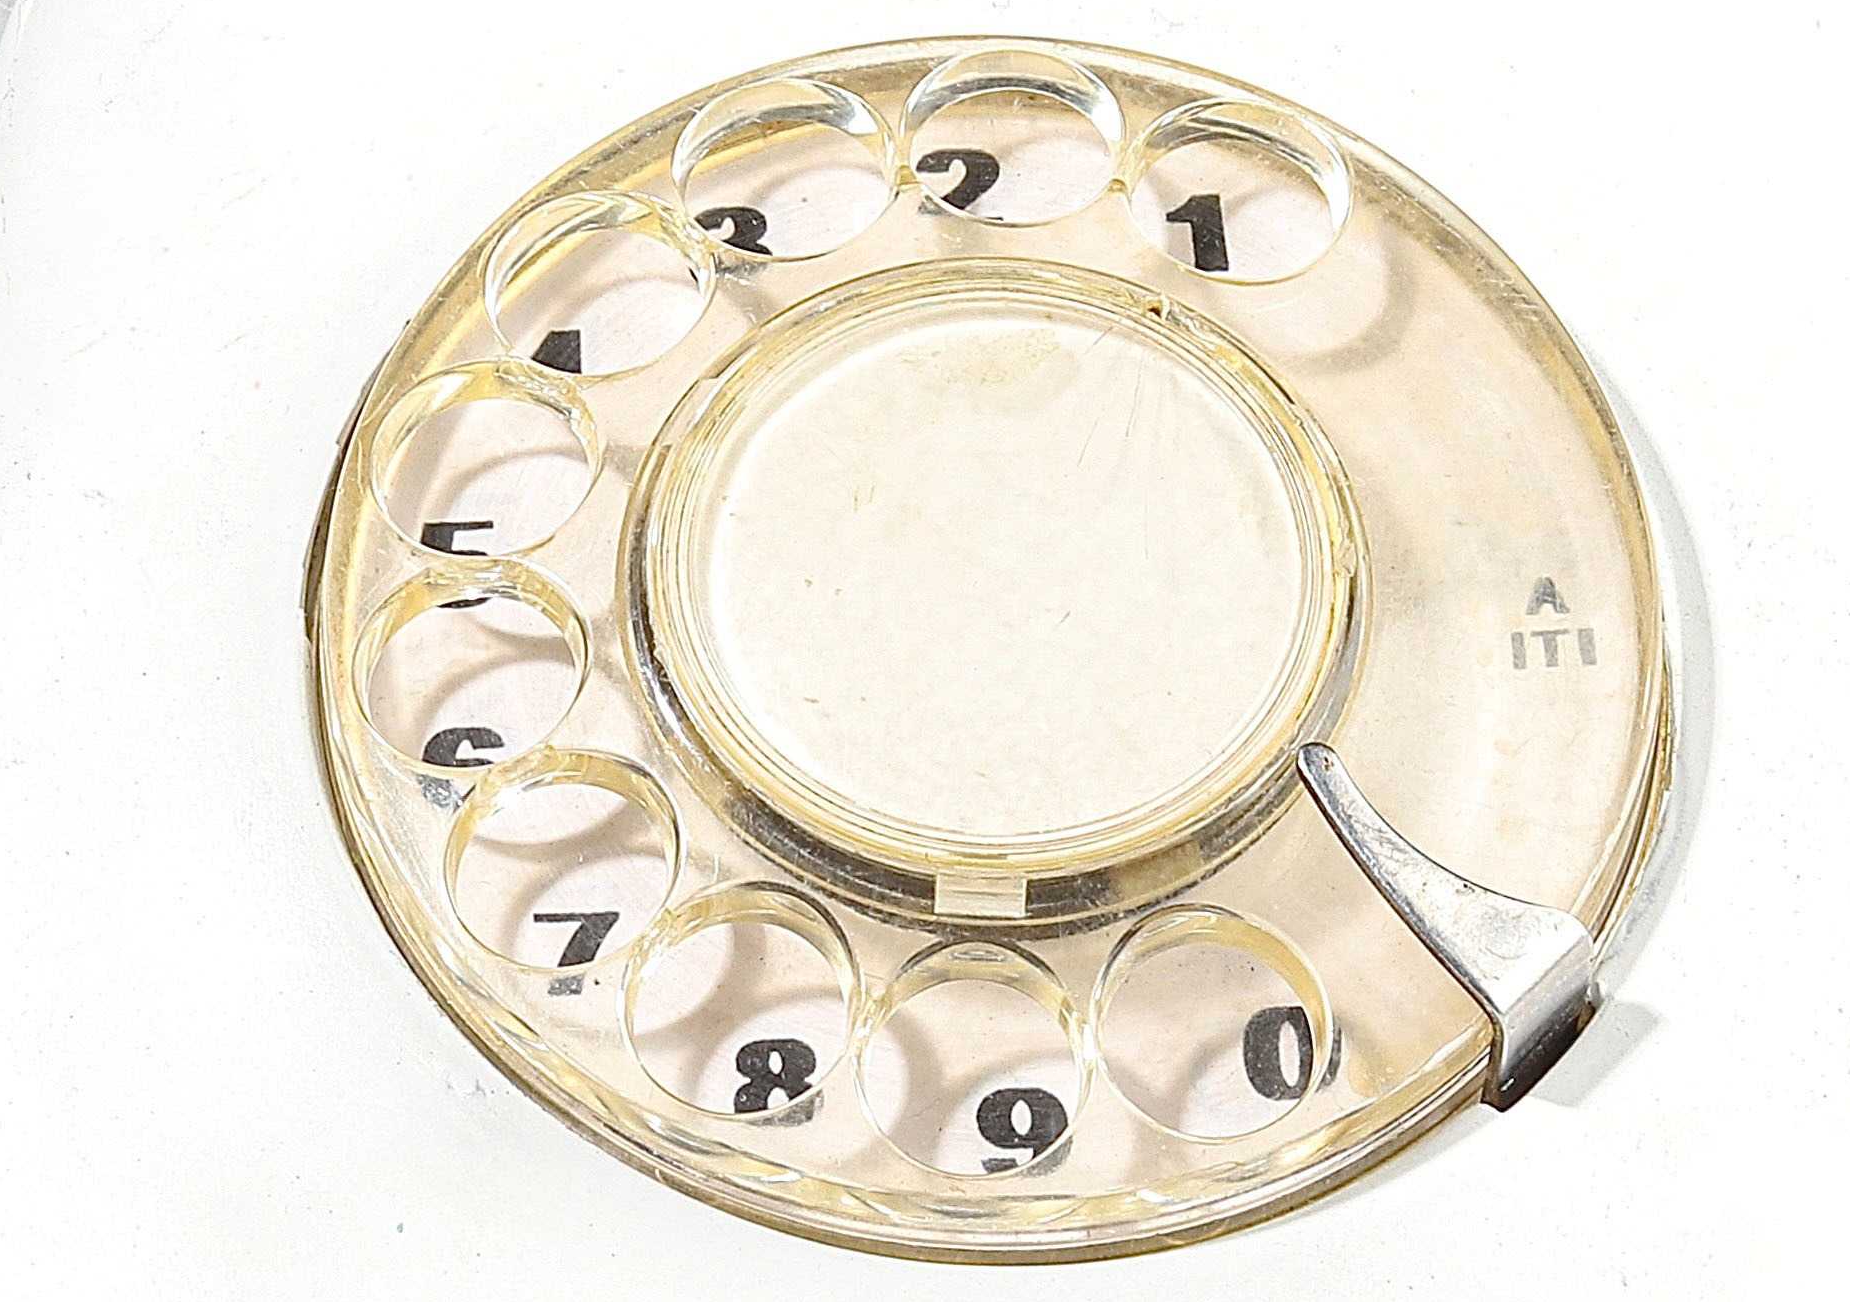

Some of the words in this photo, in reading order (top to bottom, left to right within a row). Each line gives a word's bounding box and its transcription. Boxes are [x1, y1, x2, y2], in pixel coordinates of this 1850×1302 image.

[915, 149, 1004, 221] 2
[1166, 194, 1229, 272] 1
[1525, 577, 1570, 615] A
[1511, 628, 1598, 670] ITI
[533, 911, 620, 995] 7
[734, 1038, 824, 1126] 8
[1243, 1006, 1342, 1101] 0
[976, 1088, 1074, 1177] 9
